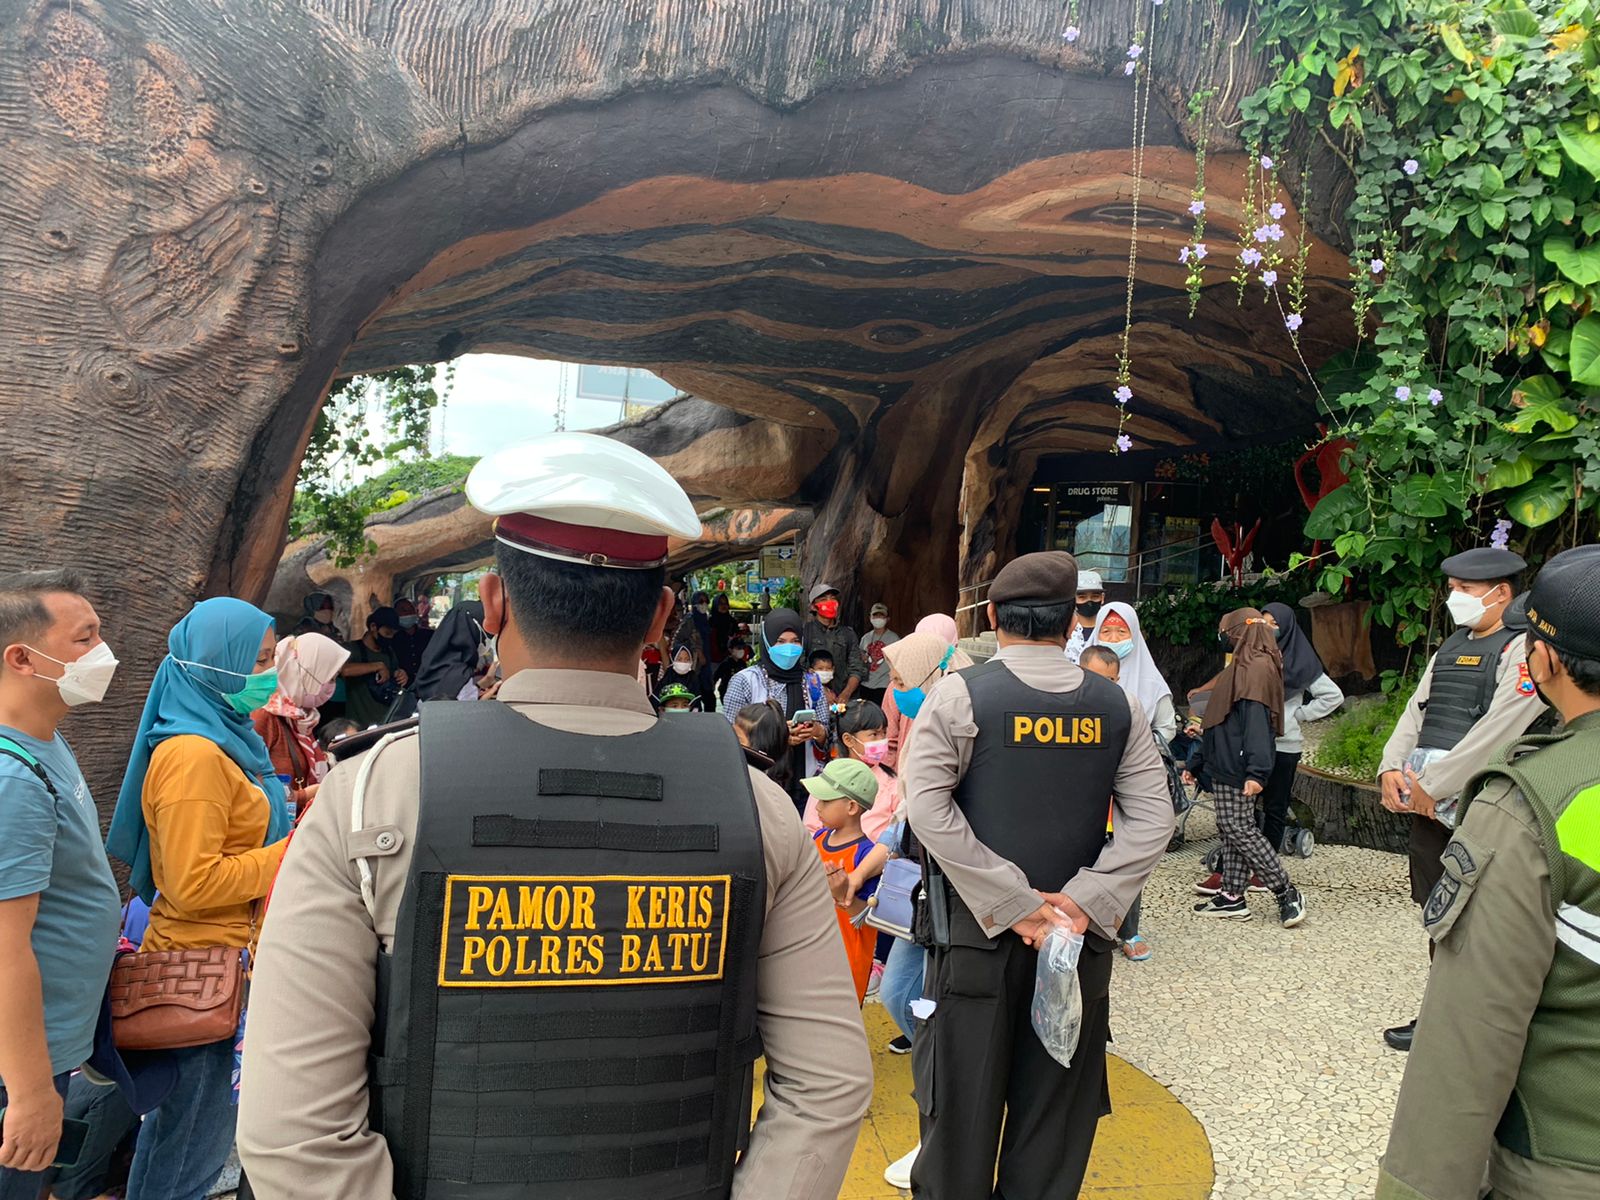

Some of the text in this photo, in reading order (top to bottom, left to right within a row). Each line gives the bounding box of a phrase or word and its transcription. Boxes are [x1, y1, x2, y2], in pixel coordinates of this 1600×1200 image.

[1068, 487, 1119, 496] DRUG STORE
[1013, 716, 1102, 744] POLISI
[464, 884, 714, 931] PAMOR KERIS
[460, 933, 713, 976] POLRES BATU
